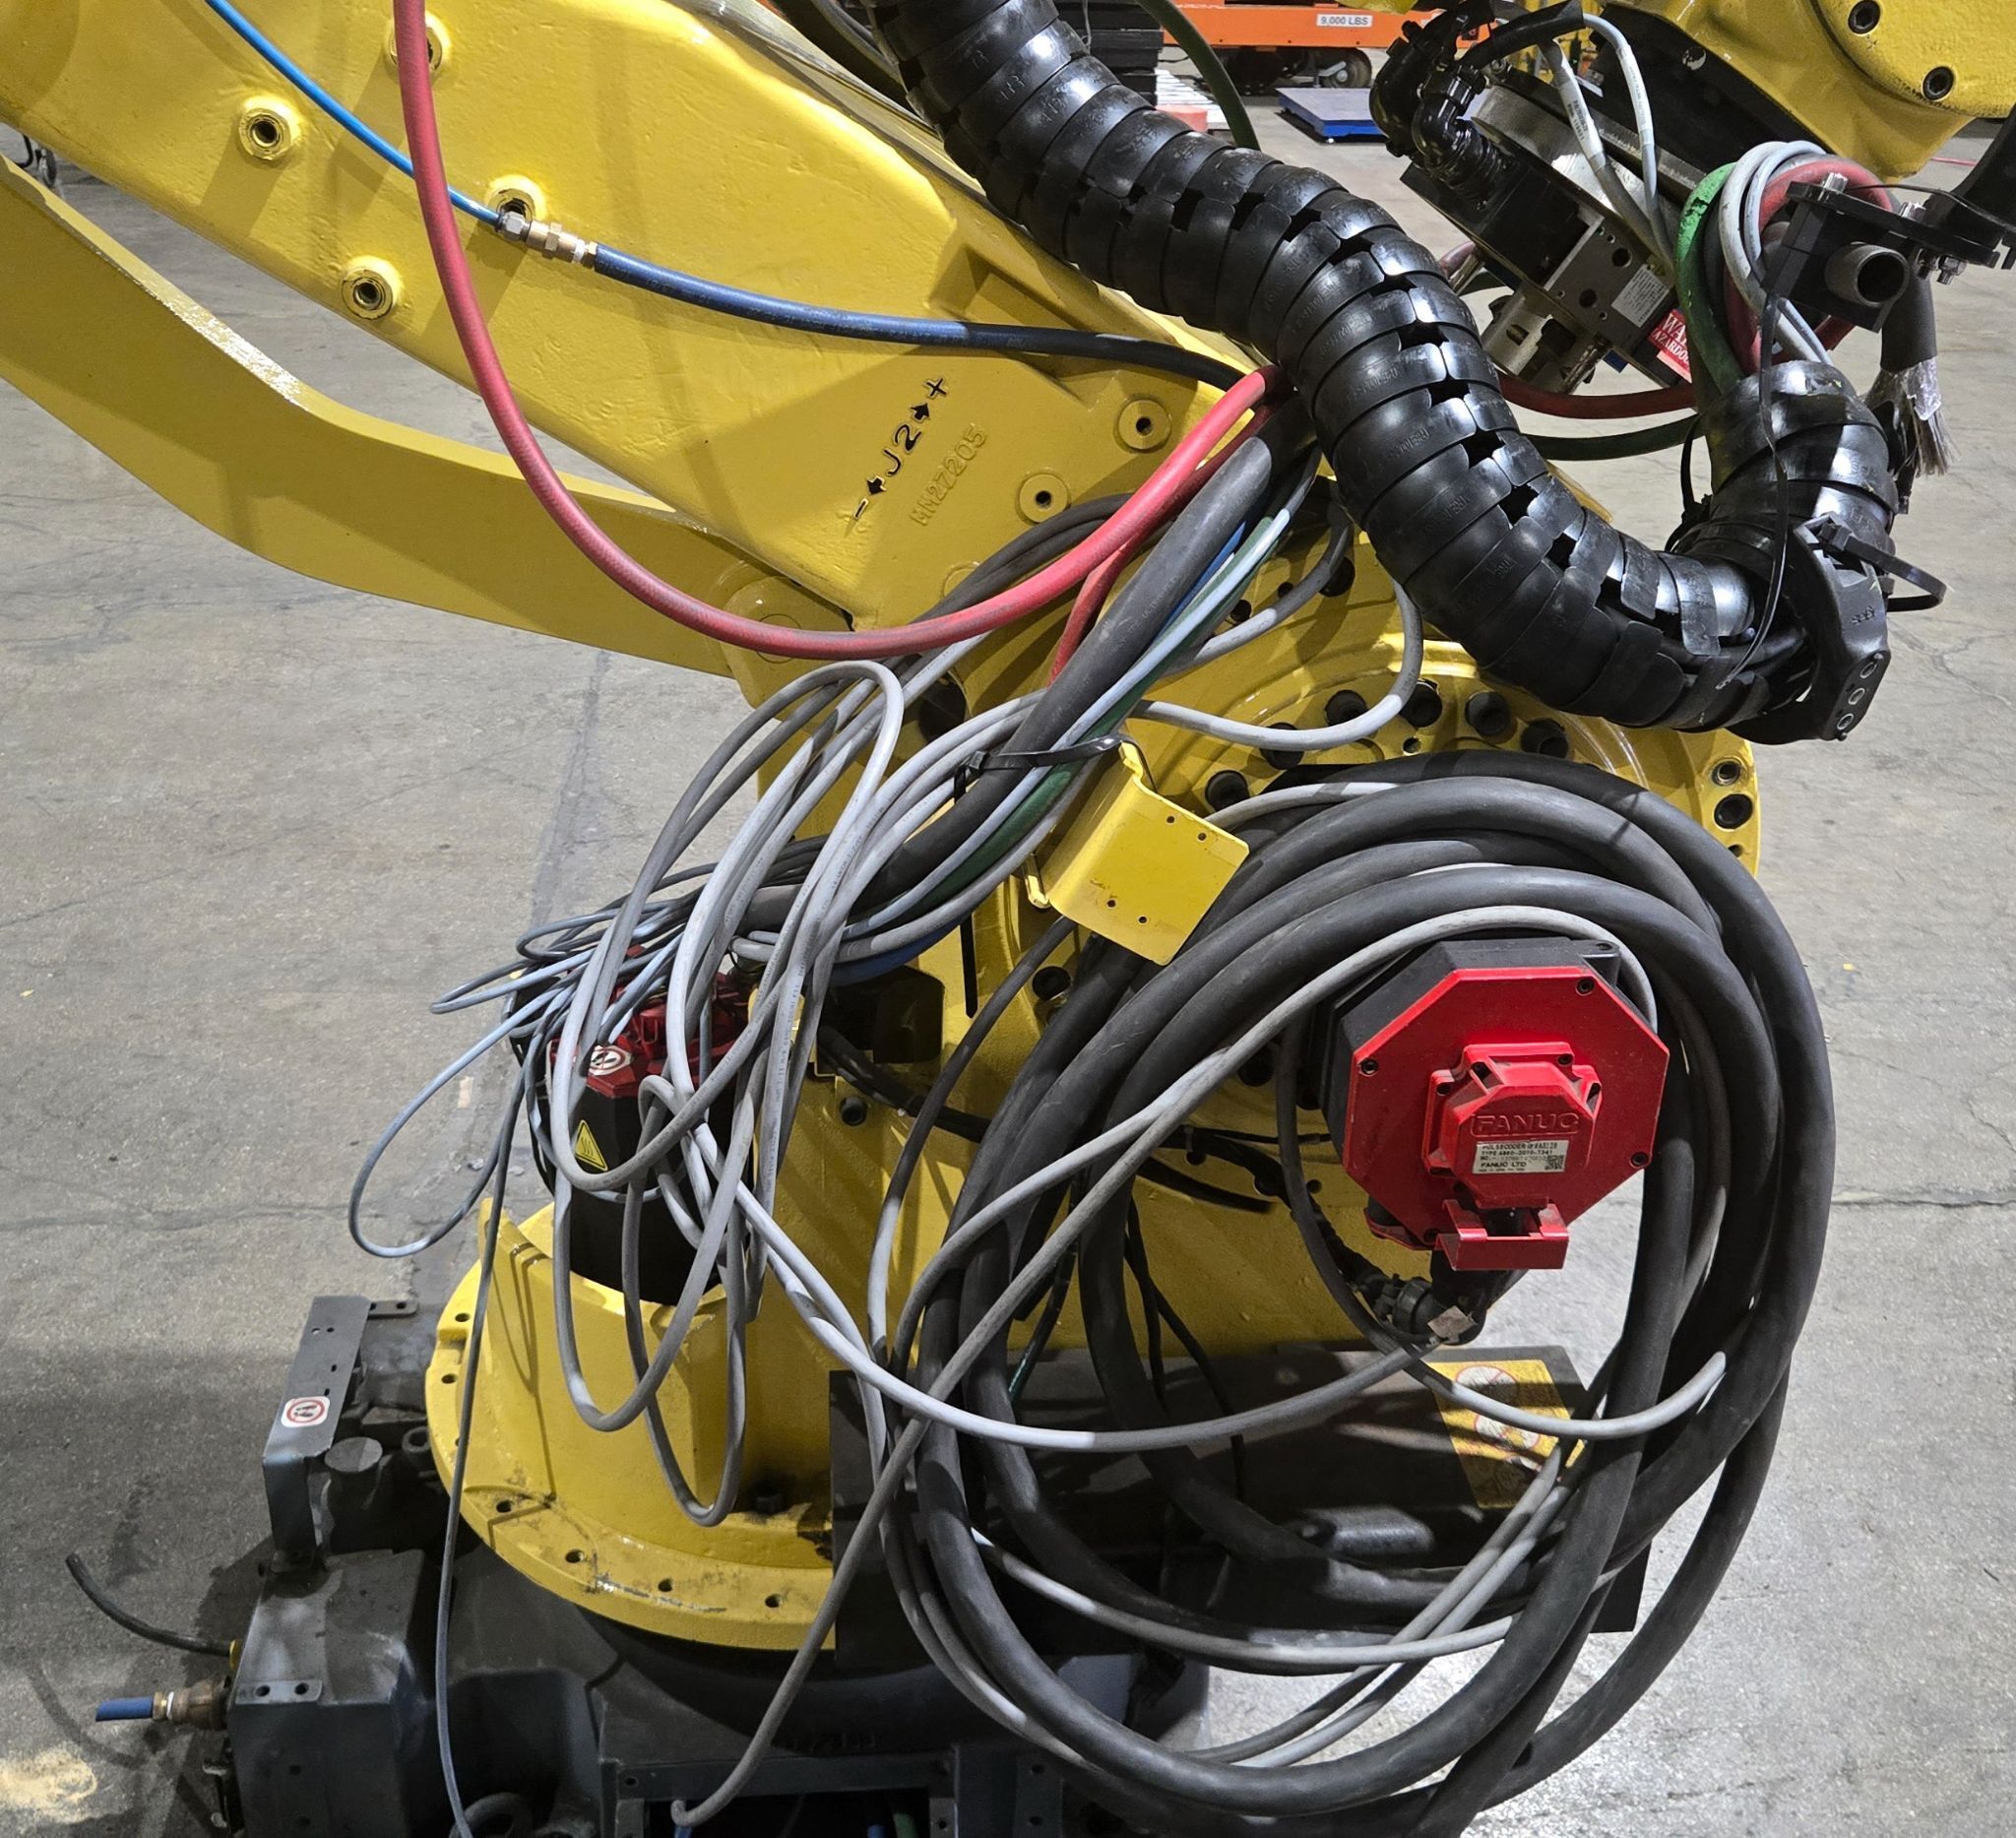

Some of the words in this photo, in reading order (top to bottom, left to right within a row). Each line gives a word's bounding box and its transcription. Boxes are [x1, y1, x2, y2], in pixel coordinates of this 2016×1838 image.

[1349, 17, 1368, 26] LBS
[883, 423, 922, 477] J2
[1477, 1111, 1580, 1133] FANUC
